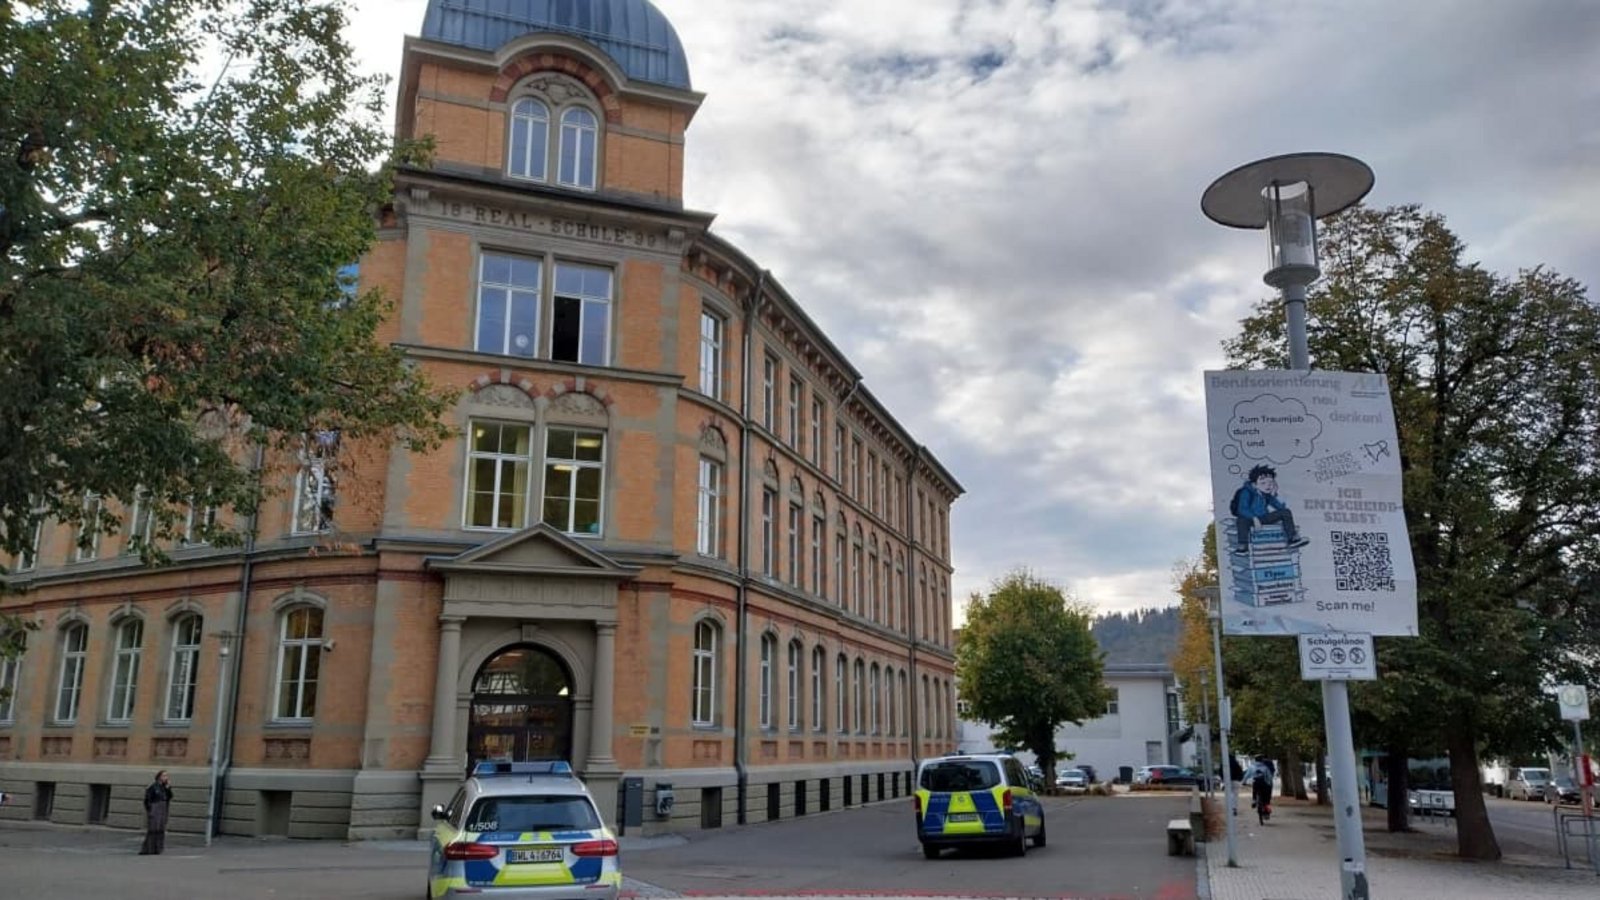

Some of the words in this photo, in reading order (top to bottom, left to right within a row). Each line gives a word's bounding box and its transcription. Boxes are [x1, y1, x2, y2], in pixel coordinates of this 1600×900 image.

[1212, 376, 1341, 391] Berufsorientierung
[1312, 395, 1338, 405] neu
[1239, 416, 1260, 424] Zum
[1262, 414, 1304, 424] Traumjob
[1233, 427, 1260, 435] durch
[1247, 439, 1265, 447] und
[1337, 487, 1362, 499] ICH
[1316, 600, 1348, 611] Scan
[1351, 601, 1376, 612] me!
